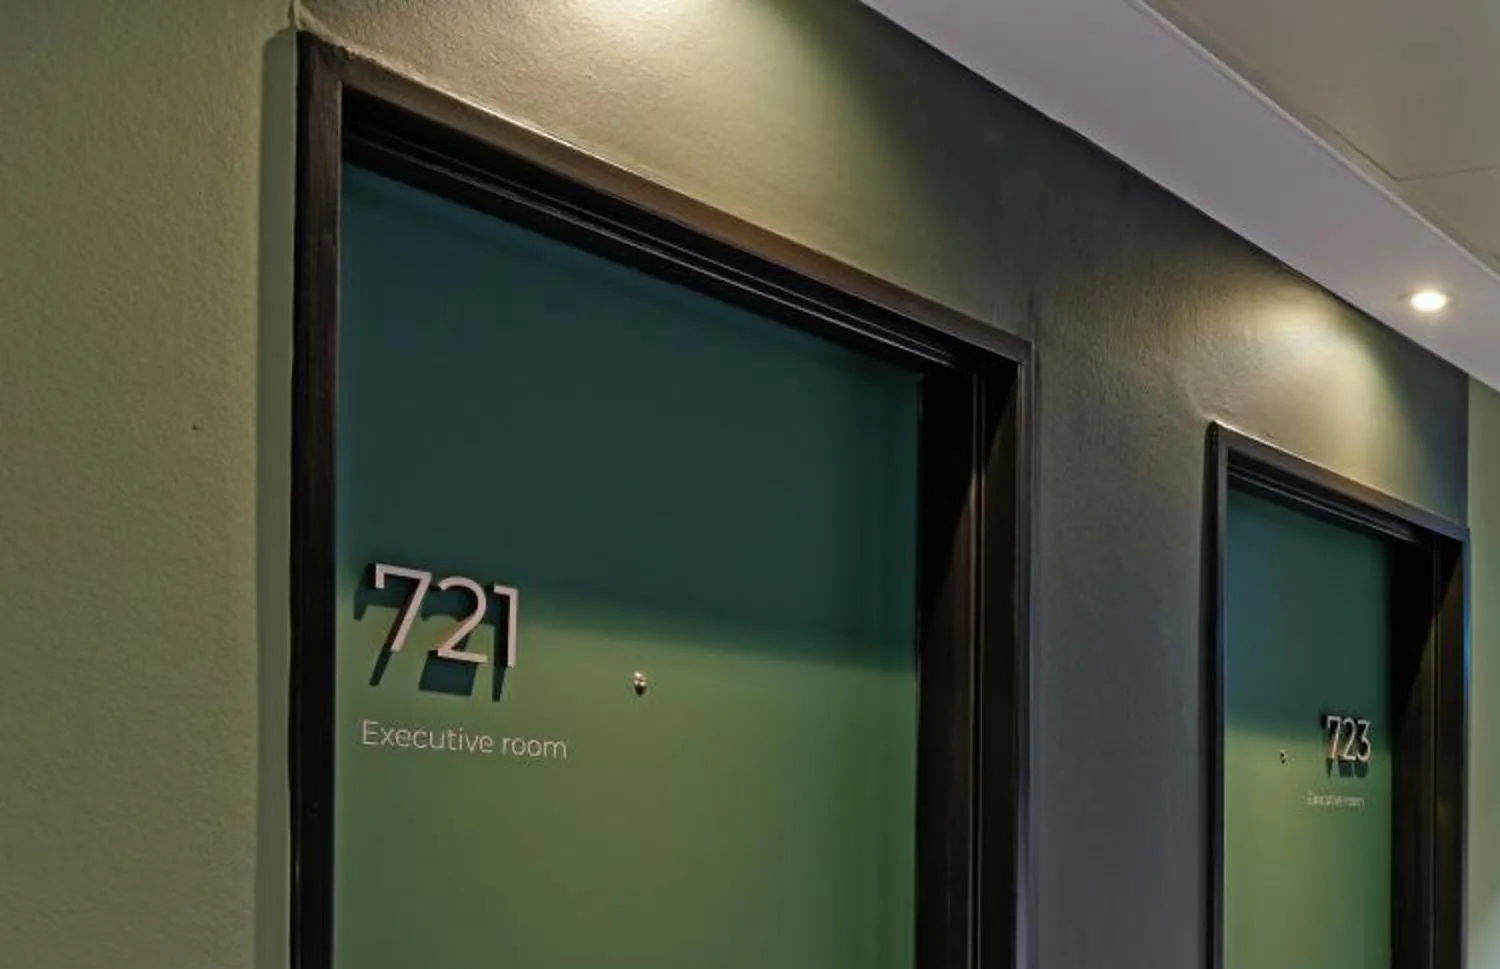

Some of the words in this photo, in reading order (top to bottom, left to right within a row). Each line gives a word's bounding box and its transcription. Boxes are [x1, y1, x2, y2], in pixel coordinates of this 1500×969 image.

[375, 563, 519, 668] 721
[361, 720, 494, 753] Executive
[502, 736, 568, 759] room
[1327, 715, 1371, 762] 723
